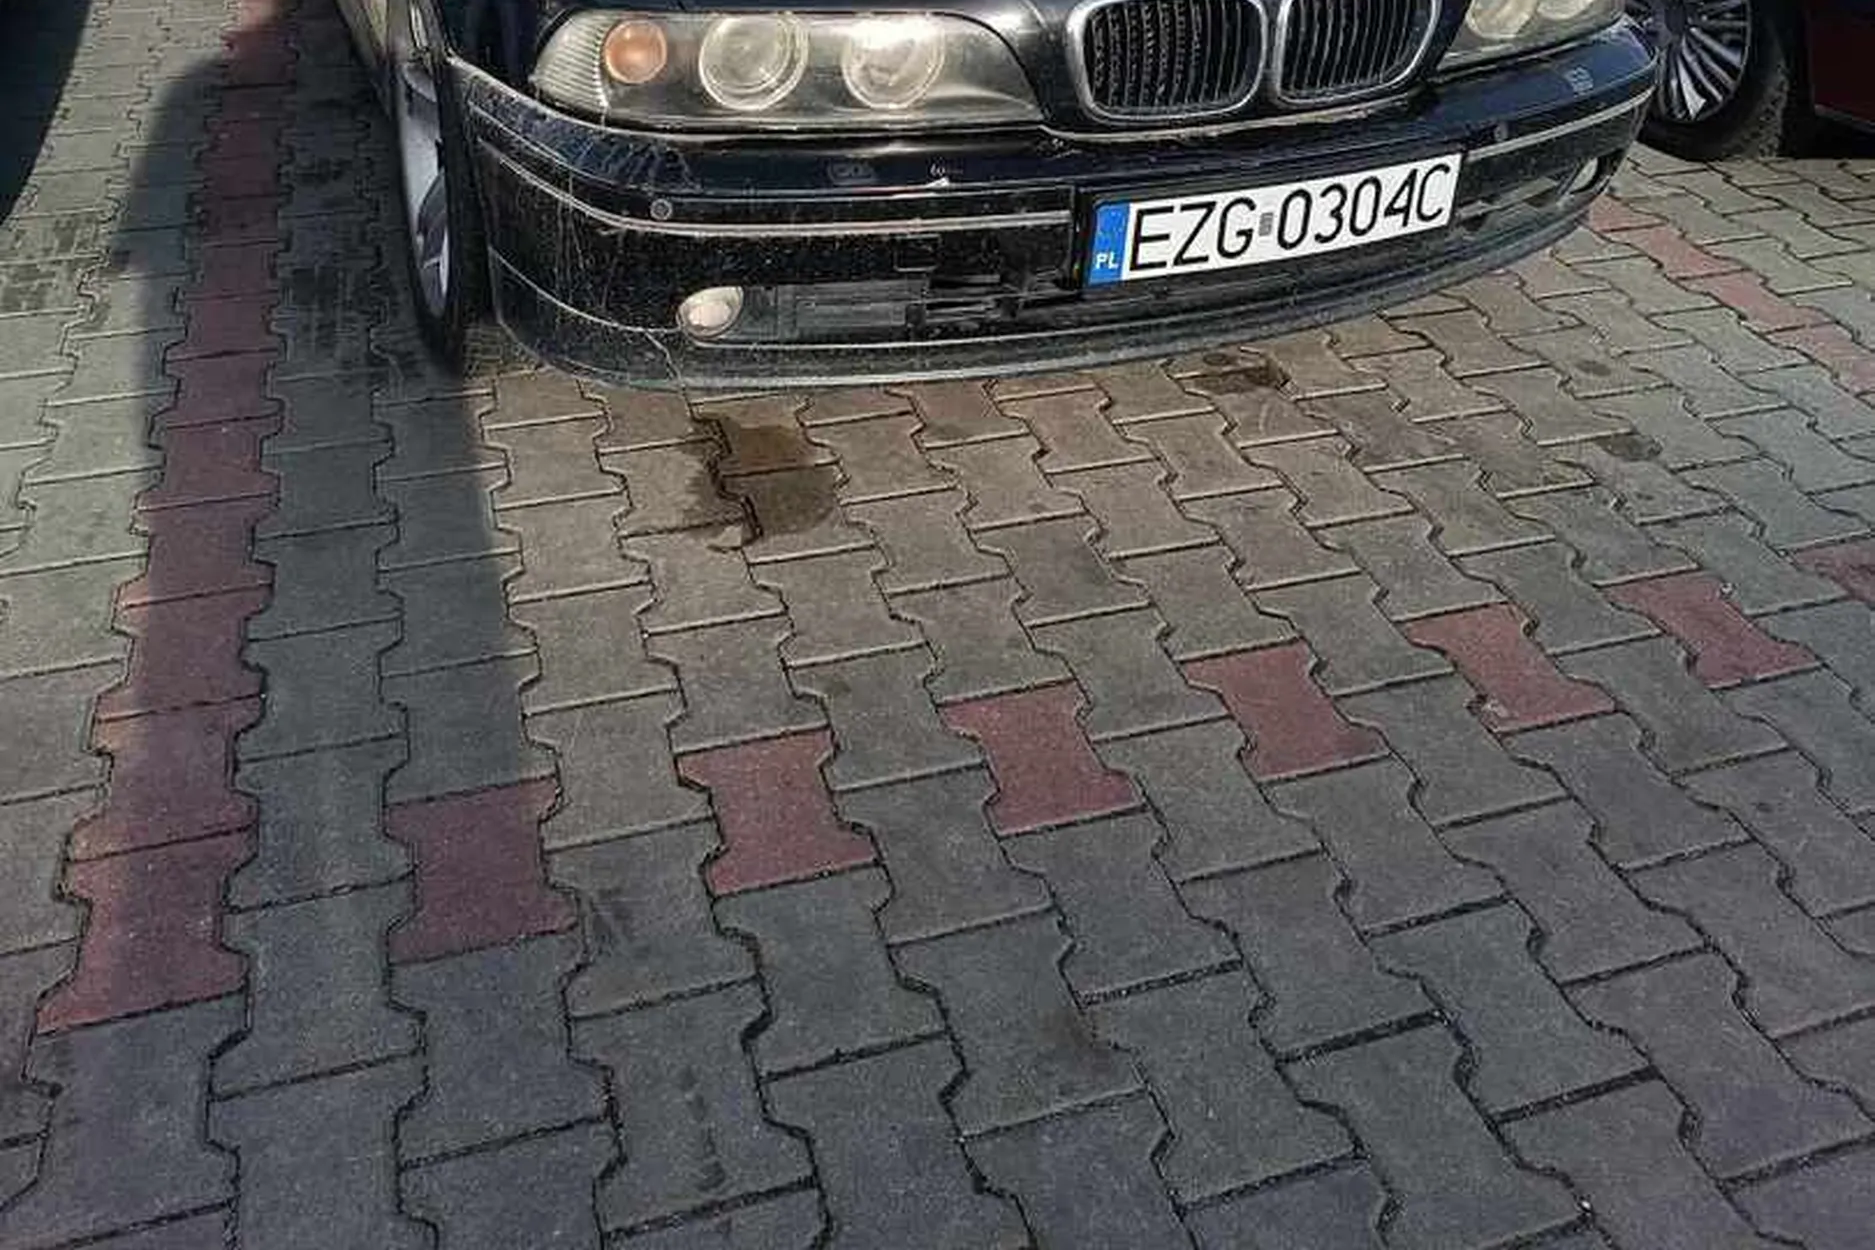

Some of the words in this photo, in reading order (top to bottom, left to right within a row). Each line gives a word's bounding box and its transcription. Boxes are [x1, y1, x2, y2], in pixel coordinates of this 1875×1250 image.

[1129, 196, 1256, 271] EZG
[1278, 164, 1450, 251] 0304C
[1096, 251, 1120, 269] PL
